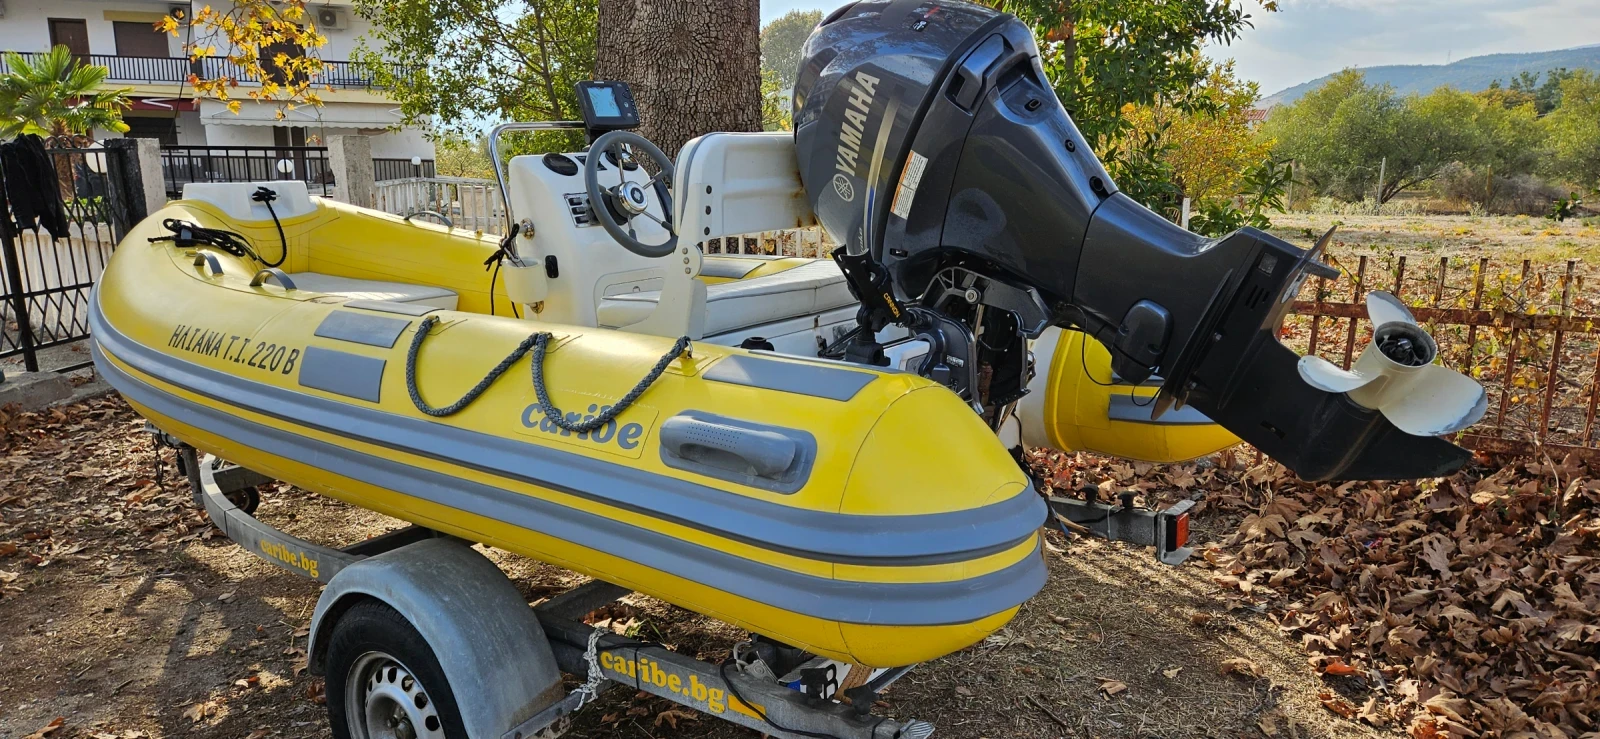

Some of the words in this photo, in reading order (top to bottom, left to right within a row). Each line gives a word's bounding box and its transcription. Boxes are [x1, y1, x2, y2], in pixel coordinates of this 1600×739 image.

[836, 71, 880, 176] YAMAHA
[260, 539, 319, 578] caribe.bg
[600, 650, 725, 714] caribe.bg
